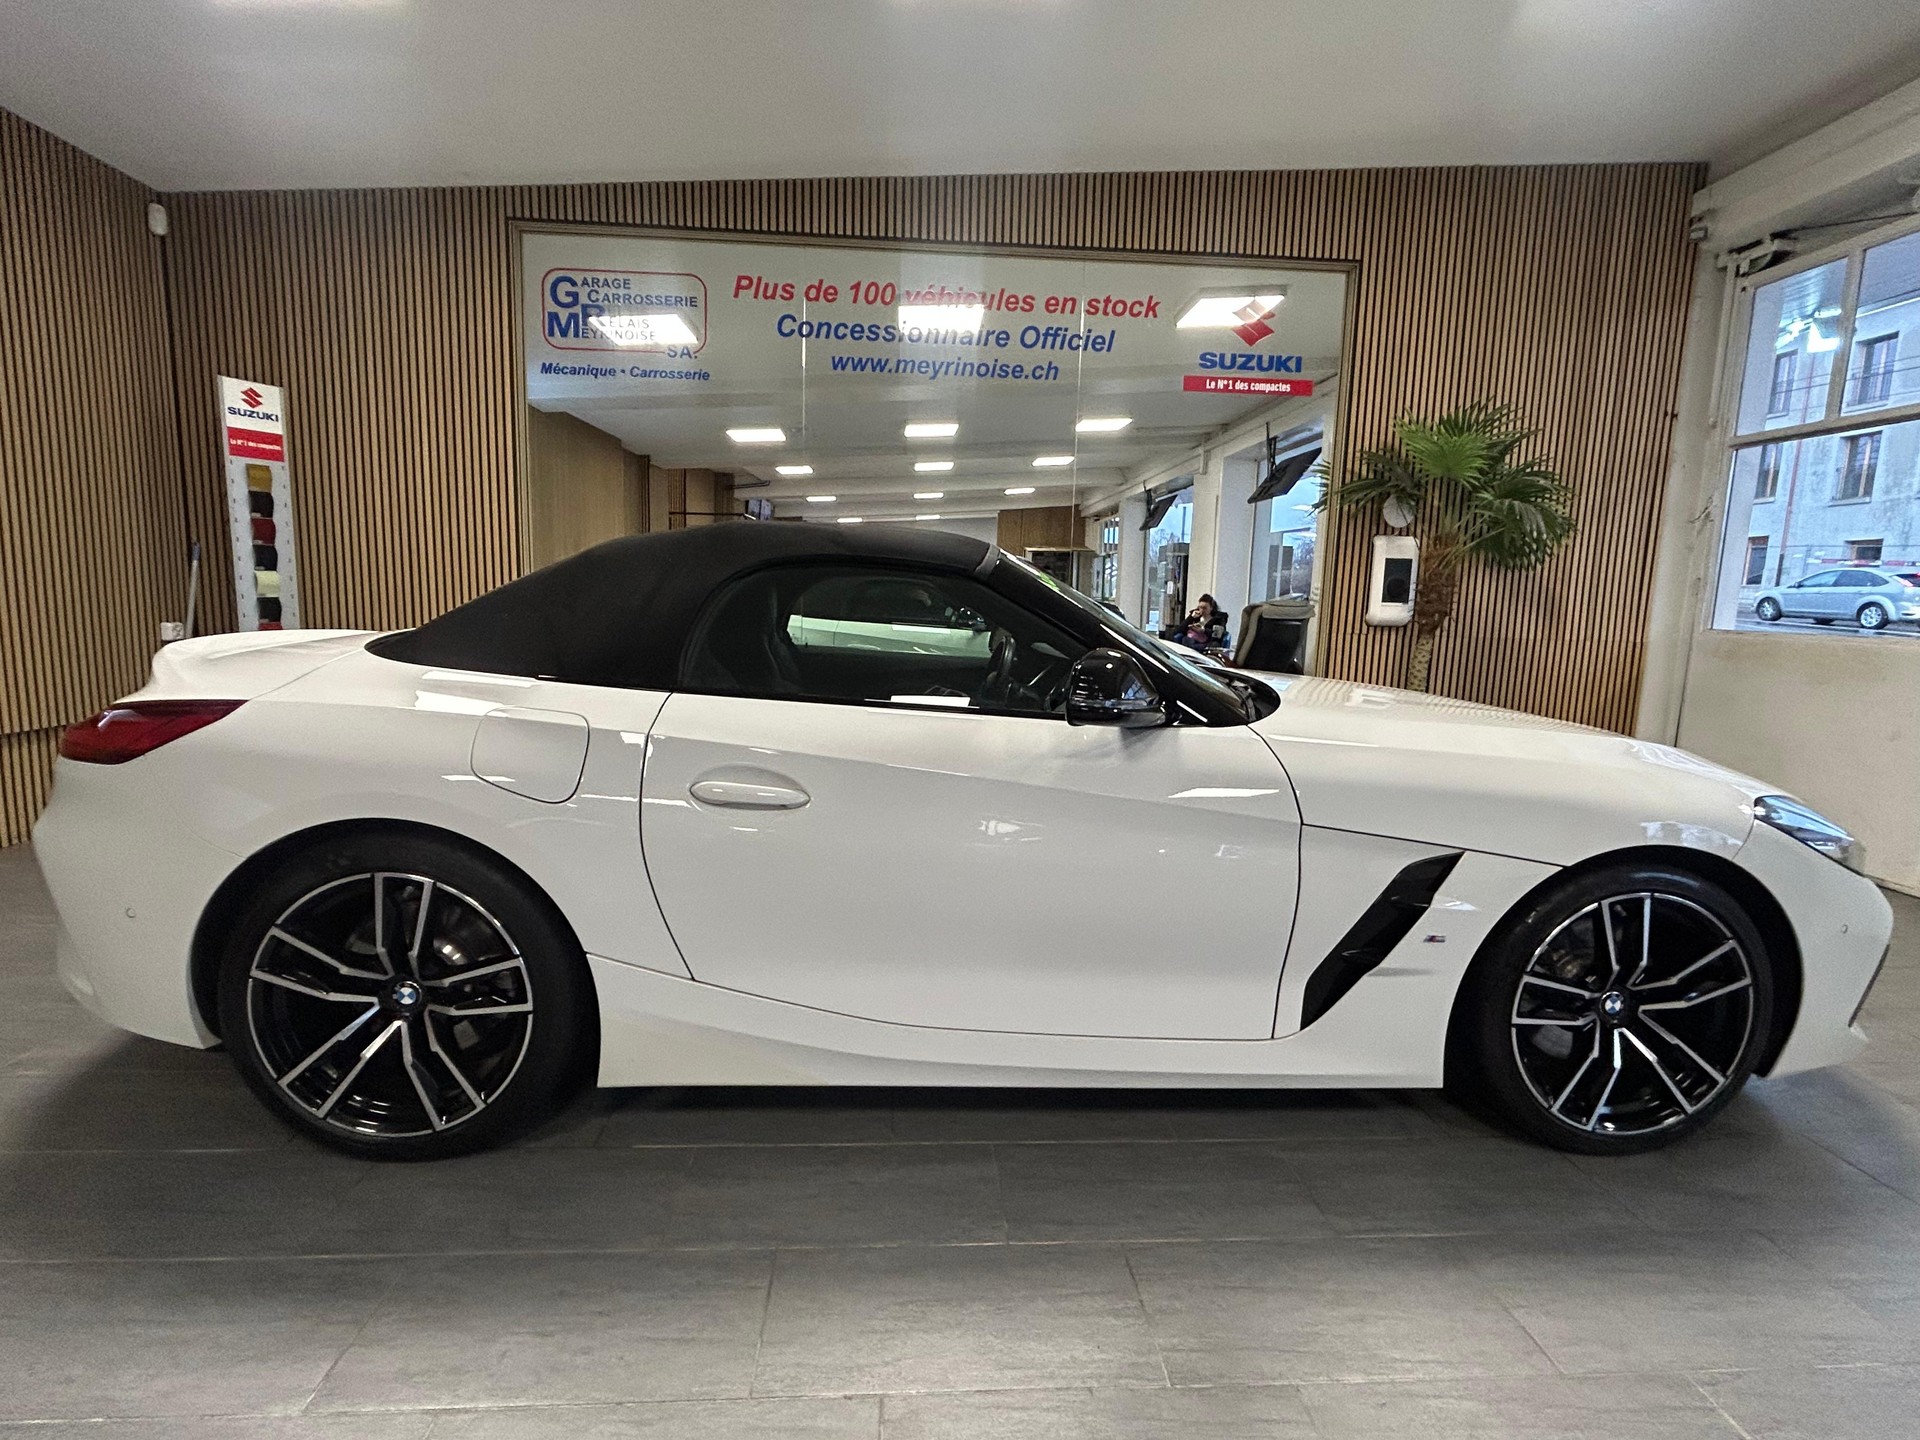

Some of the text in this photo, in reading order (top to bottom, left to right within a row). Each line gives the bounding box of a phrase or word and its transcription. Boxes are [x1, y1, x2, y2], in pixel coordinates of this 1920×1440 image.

[587, 289, 698, 308] CARROSSERIE
[733, 275, 795, 300] Plus
[804, 278, 839, 303] de
[849, 280, 897, 306] 100
[1045, 295, 1077, 315] en
[1085, 295, 1161, 318] stock
[777, 313, 1116, 352] Concessionnaire Officiel
[540, 361, 711, 381] Mécanique Carrosserie
[831, 355, 1060, 381] www.meyrinoise.ch
[1198, 351, 1303, 374] SUZUKI
[1206, 378, 1215, 389] Le
[1235, 380, 1249, 391] des
[1250, 382, 1291, 393] compactes
[227, 407, 279, 422] SUZUKI
